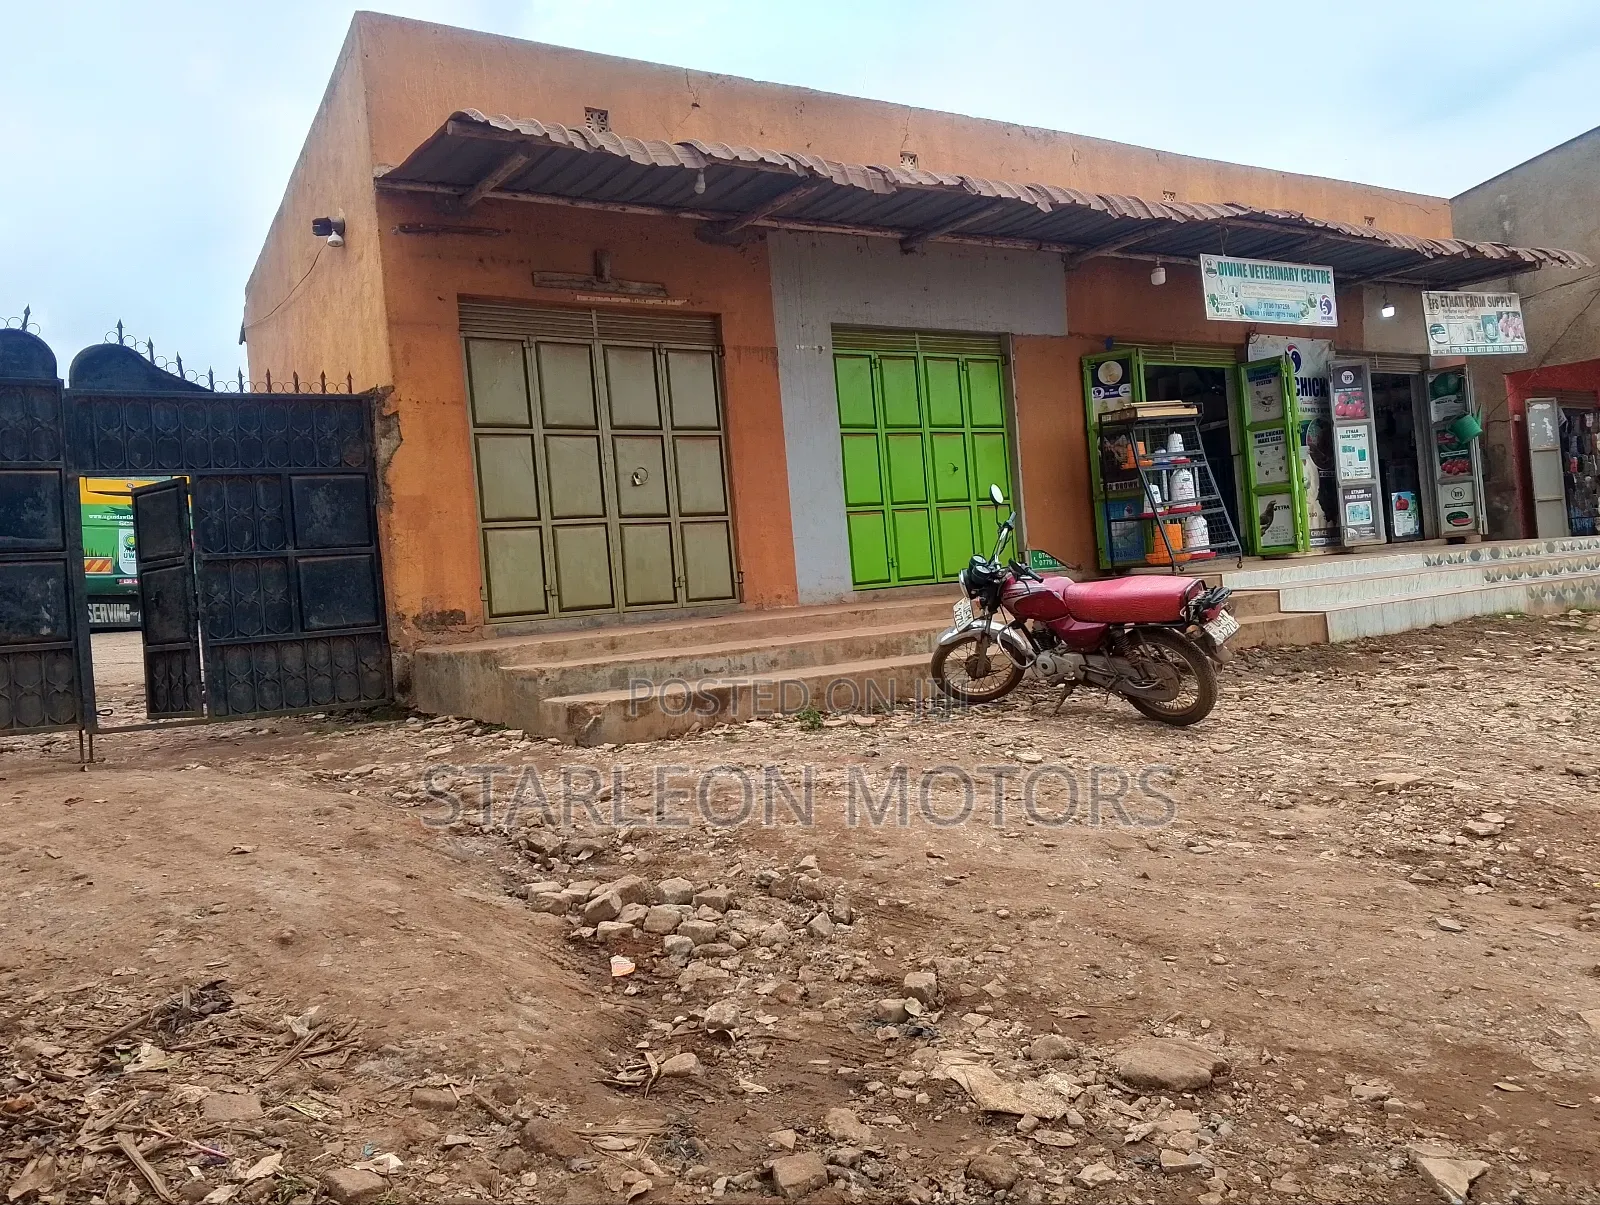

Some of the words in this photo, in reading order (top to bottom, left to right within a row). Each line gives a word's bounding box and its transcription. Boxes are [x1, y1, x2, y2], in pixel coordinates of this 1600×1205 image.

[1217, 261, 1247, 278] DIVINE
[1248, 264, 1299, 282] VETERINARY
[1300, 269, 1331, 285] CENTRE
[1440, 295, 1465, 308] ETHAN
[1466, 296, 1486, 308] FARM
[1487, 296, 1513, 308] SUPPLY
[1218, 619, 1238, 640] 127U
